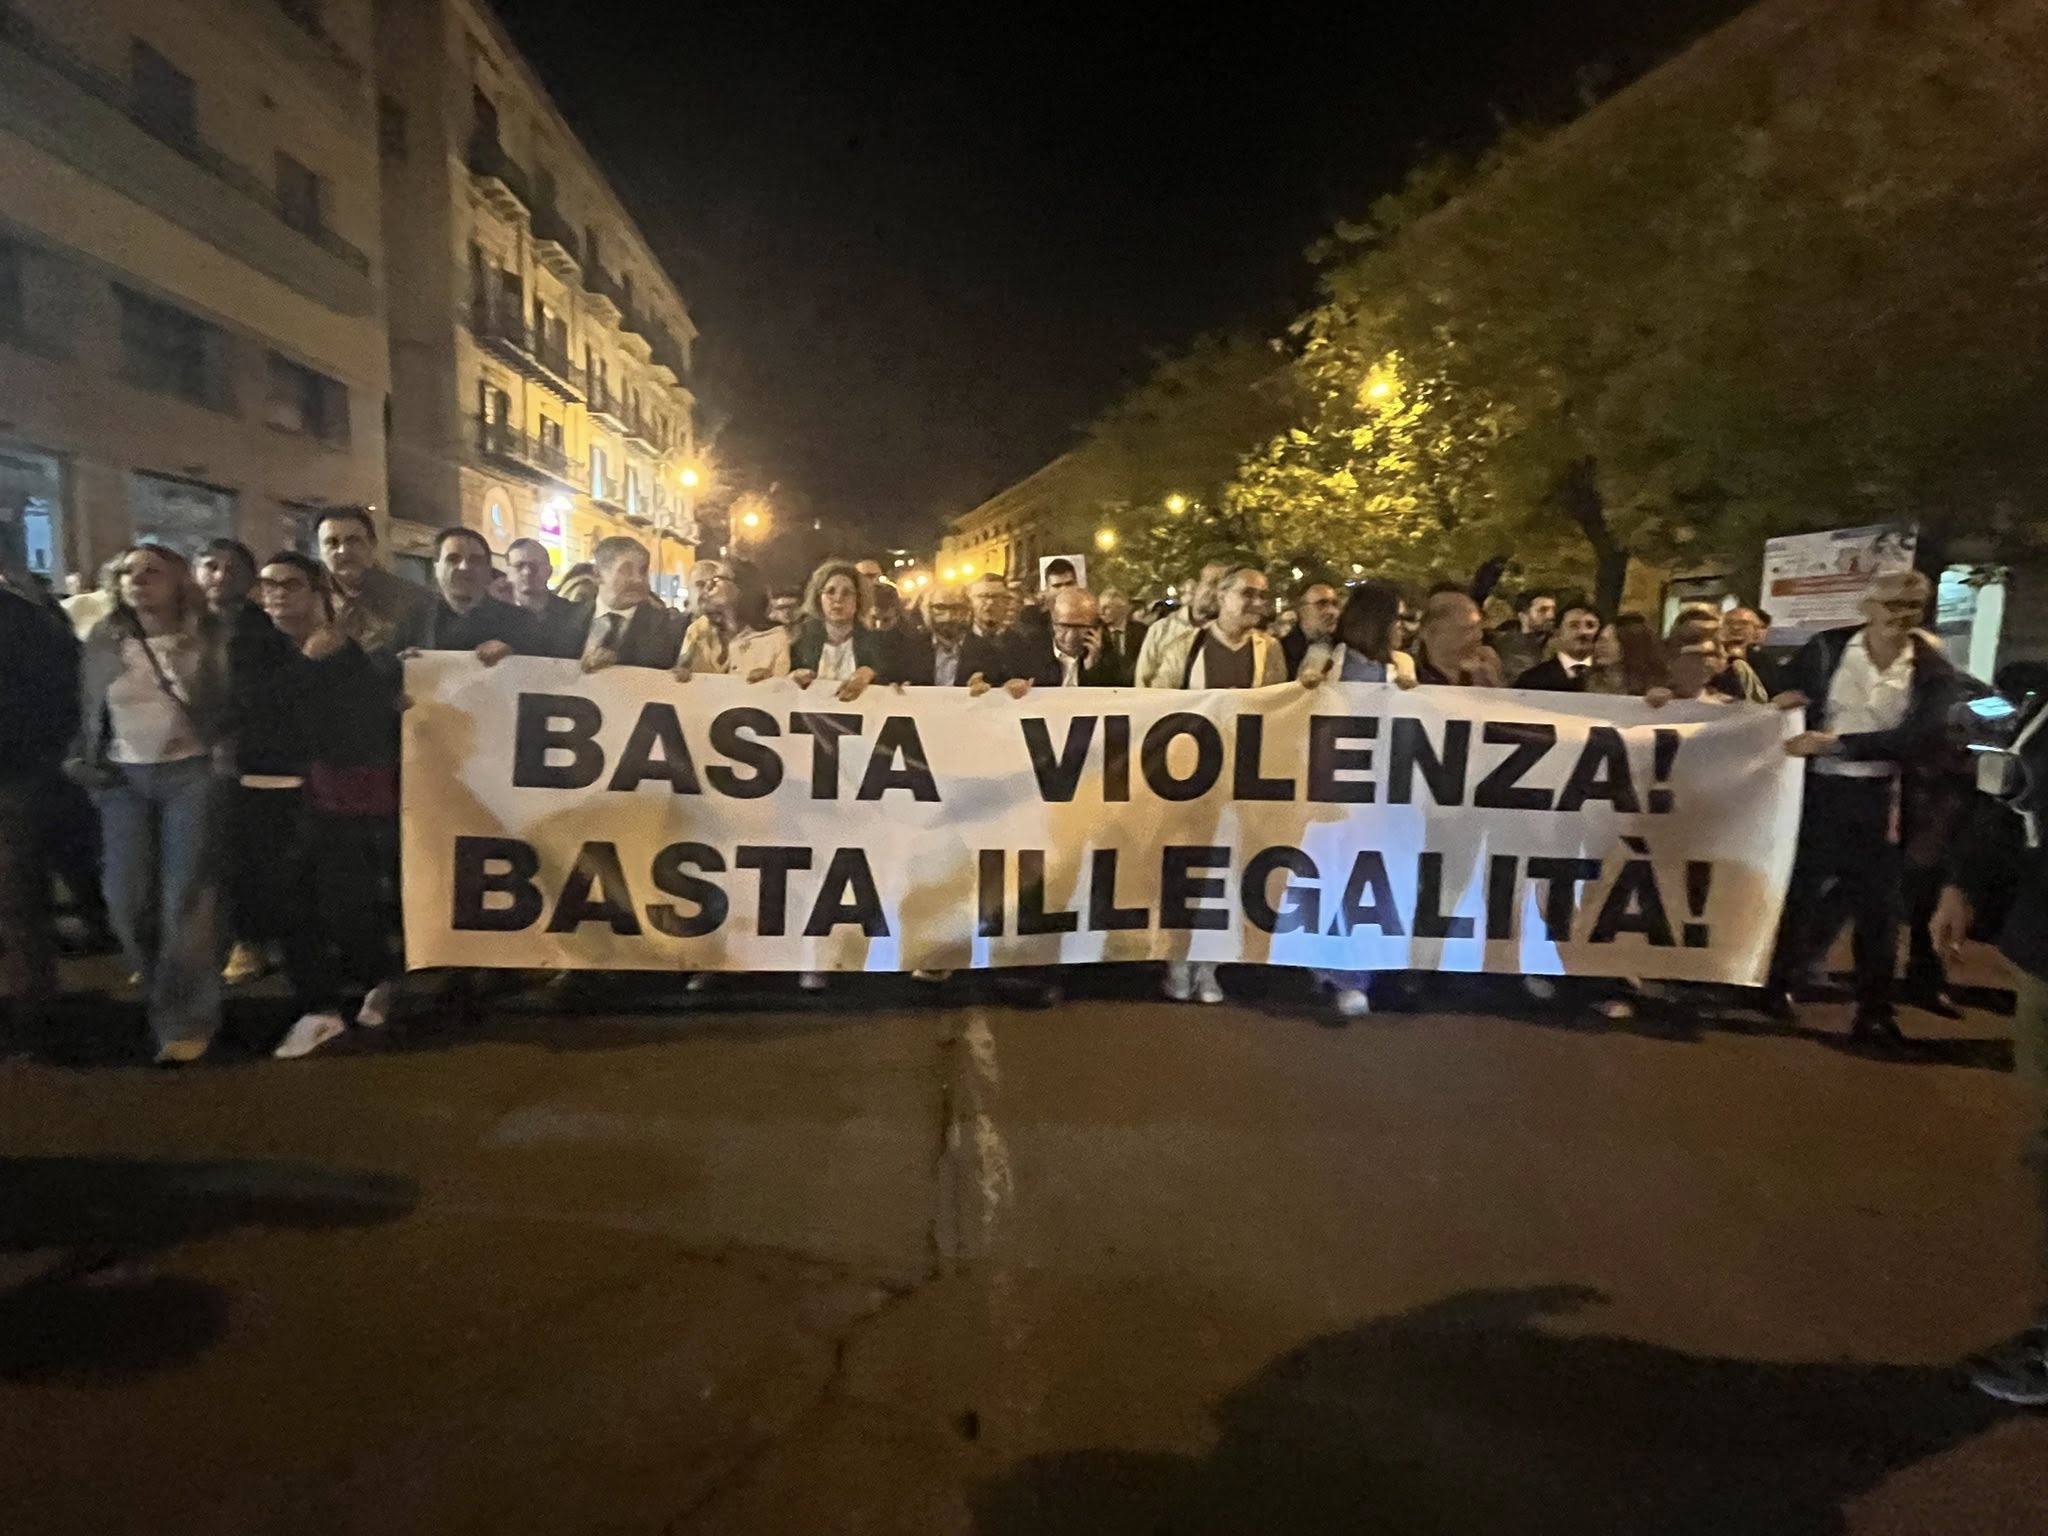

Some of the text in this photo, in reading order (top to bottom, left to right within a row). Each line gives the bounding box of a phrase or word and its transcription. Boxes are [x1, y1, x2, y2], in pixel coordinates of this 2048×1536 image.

[513, 693, 1682, 814] BASTA VIOLENZA!
[452, 835, 1712, 948] BASTA ILLEGALITÀ!
